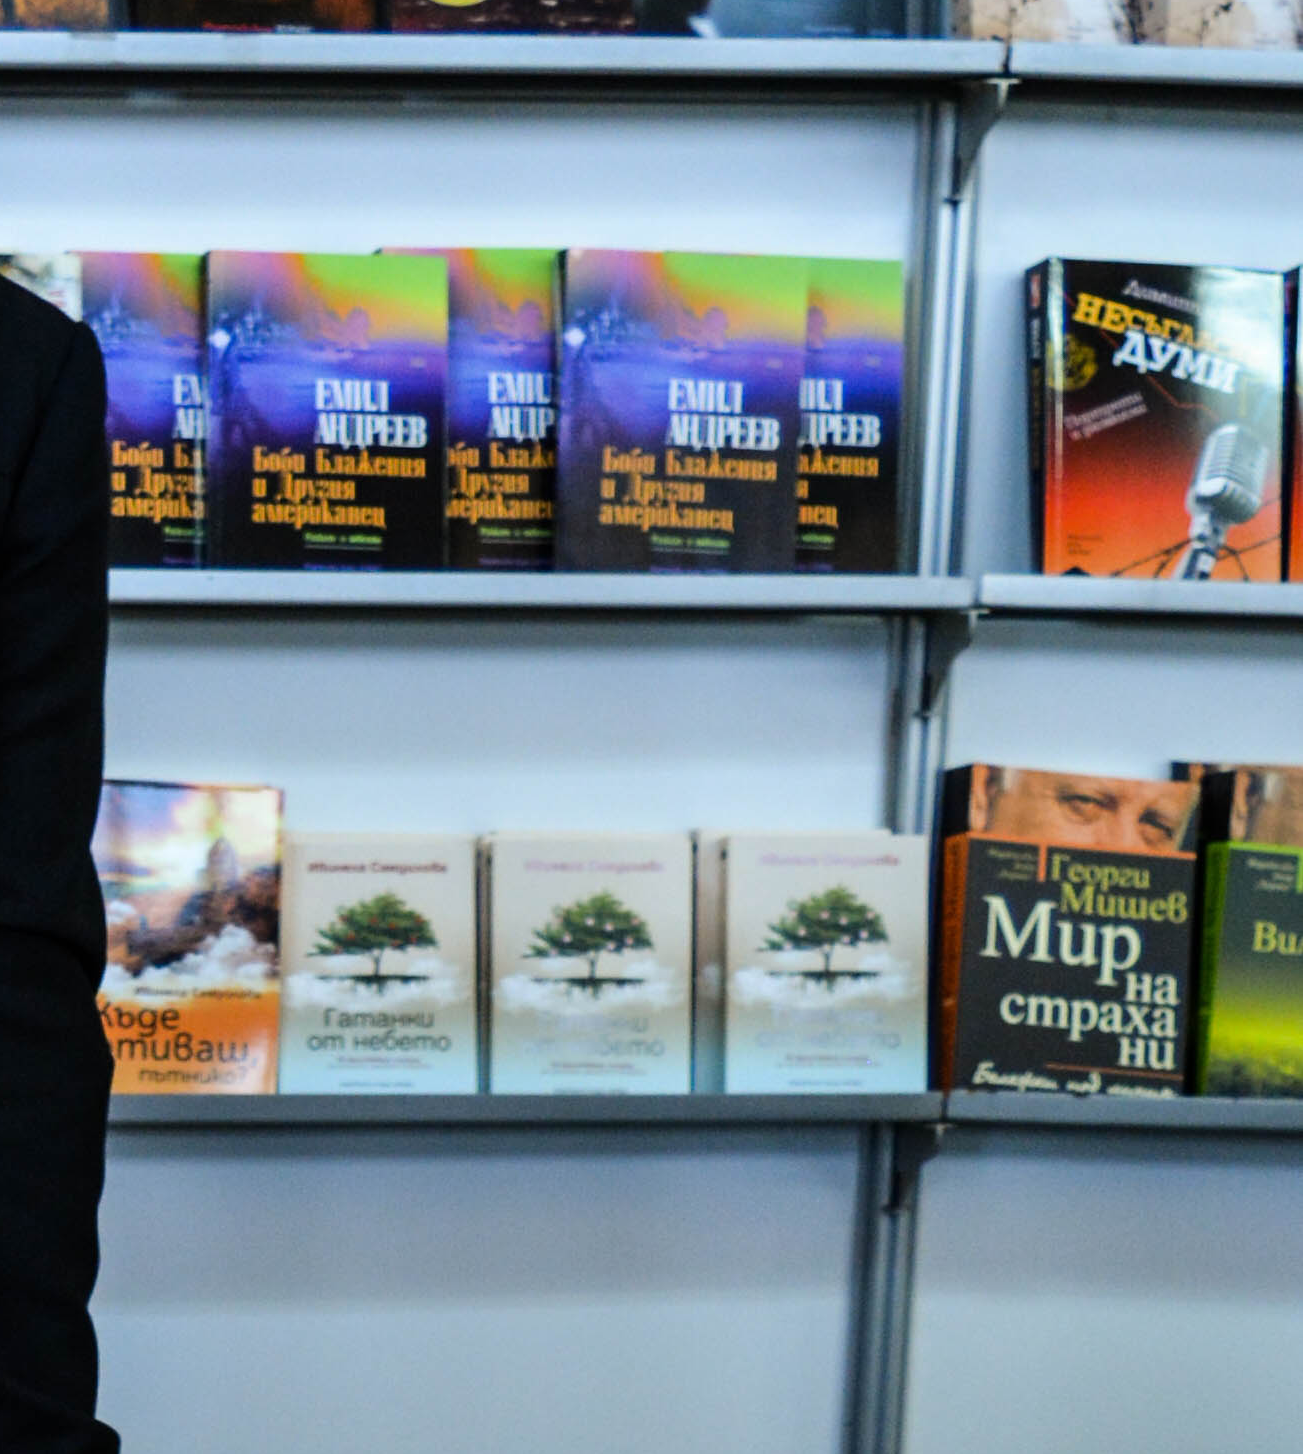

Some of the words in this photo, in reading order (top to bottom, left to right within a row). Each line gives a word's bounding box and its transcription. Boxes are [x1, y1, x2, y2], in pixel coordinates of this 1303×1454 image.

[1112, 330, 1240, 394] ДУМИ
[314, 378, 389, 413] ЕМИЛ
[314, 412, 428, 450] АНДРЕЕВ
[1050, 853, 1151, 890] Георги
[1060, 882, 1189, 924] Мишев
[980, 894, 1143, 987] Мир
[1123, 973, 1179, 1007] на
[323, 1008, 435, 1031] Гатанки
[999, 990, 1179, 1044] страха
[306, 1033, 348, 1053] от
[353, 1030, 452, 1053] небето
[1117, 1035, 1176, 1071] ни
